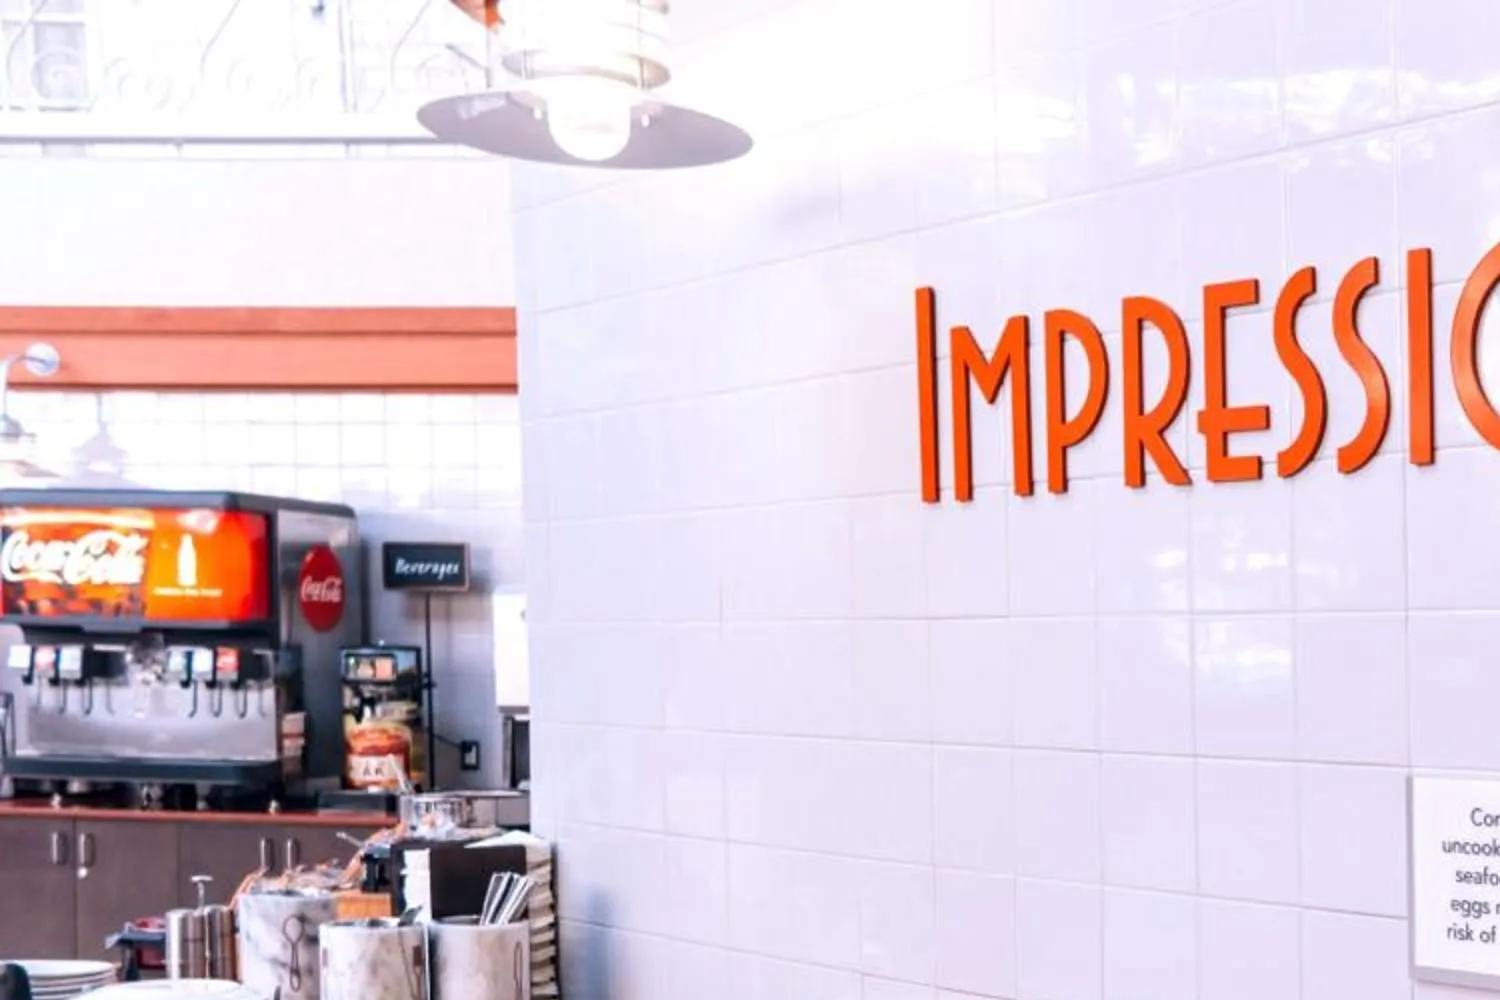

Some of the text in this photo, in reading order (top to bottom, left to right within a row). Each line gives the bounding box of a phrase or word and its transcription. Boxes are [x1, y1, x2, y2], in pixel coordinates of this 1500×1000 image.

[394, 557, 460, 581] Beverages
[1449, 899, 1491, 920] eggs
[1446, 922, 1475, 942] risk
[1479, 924, 1498, 944] of
